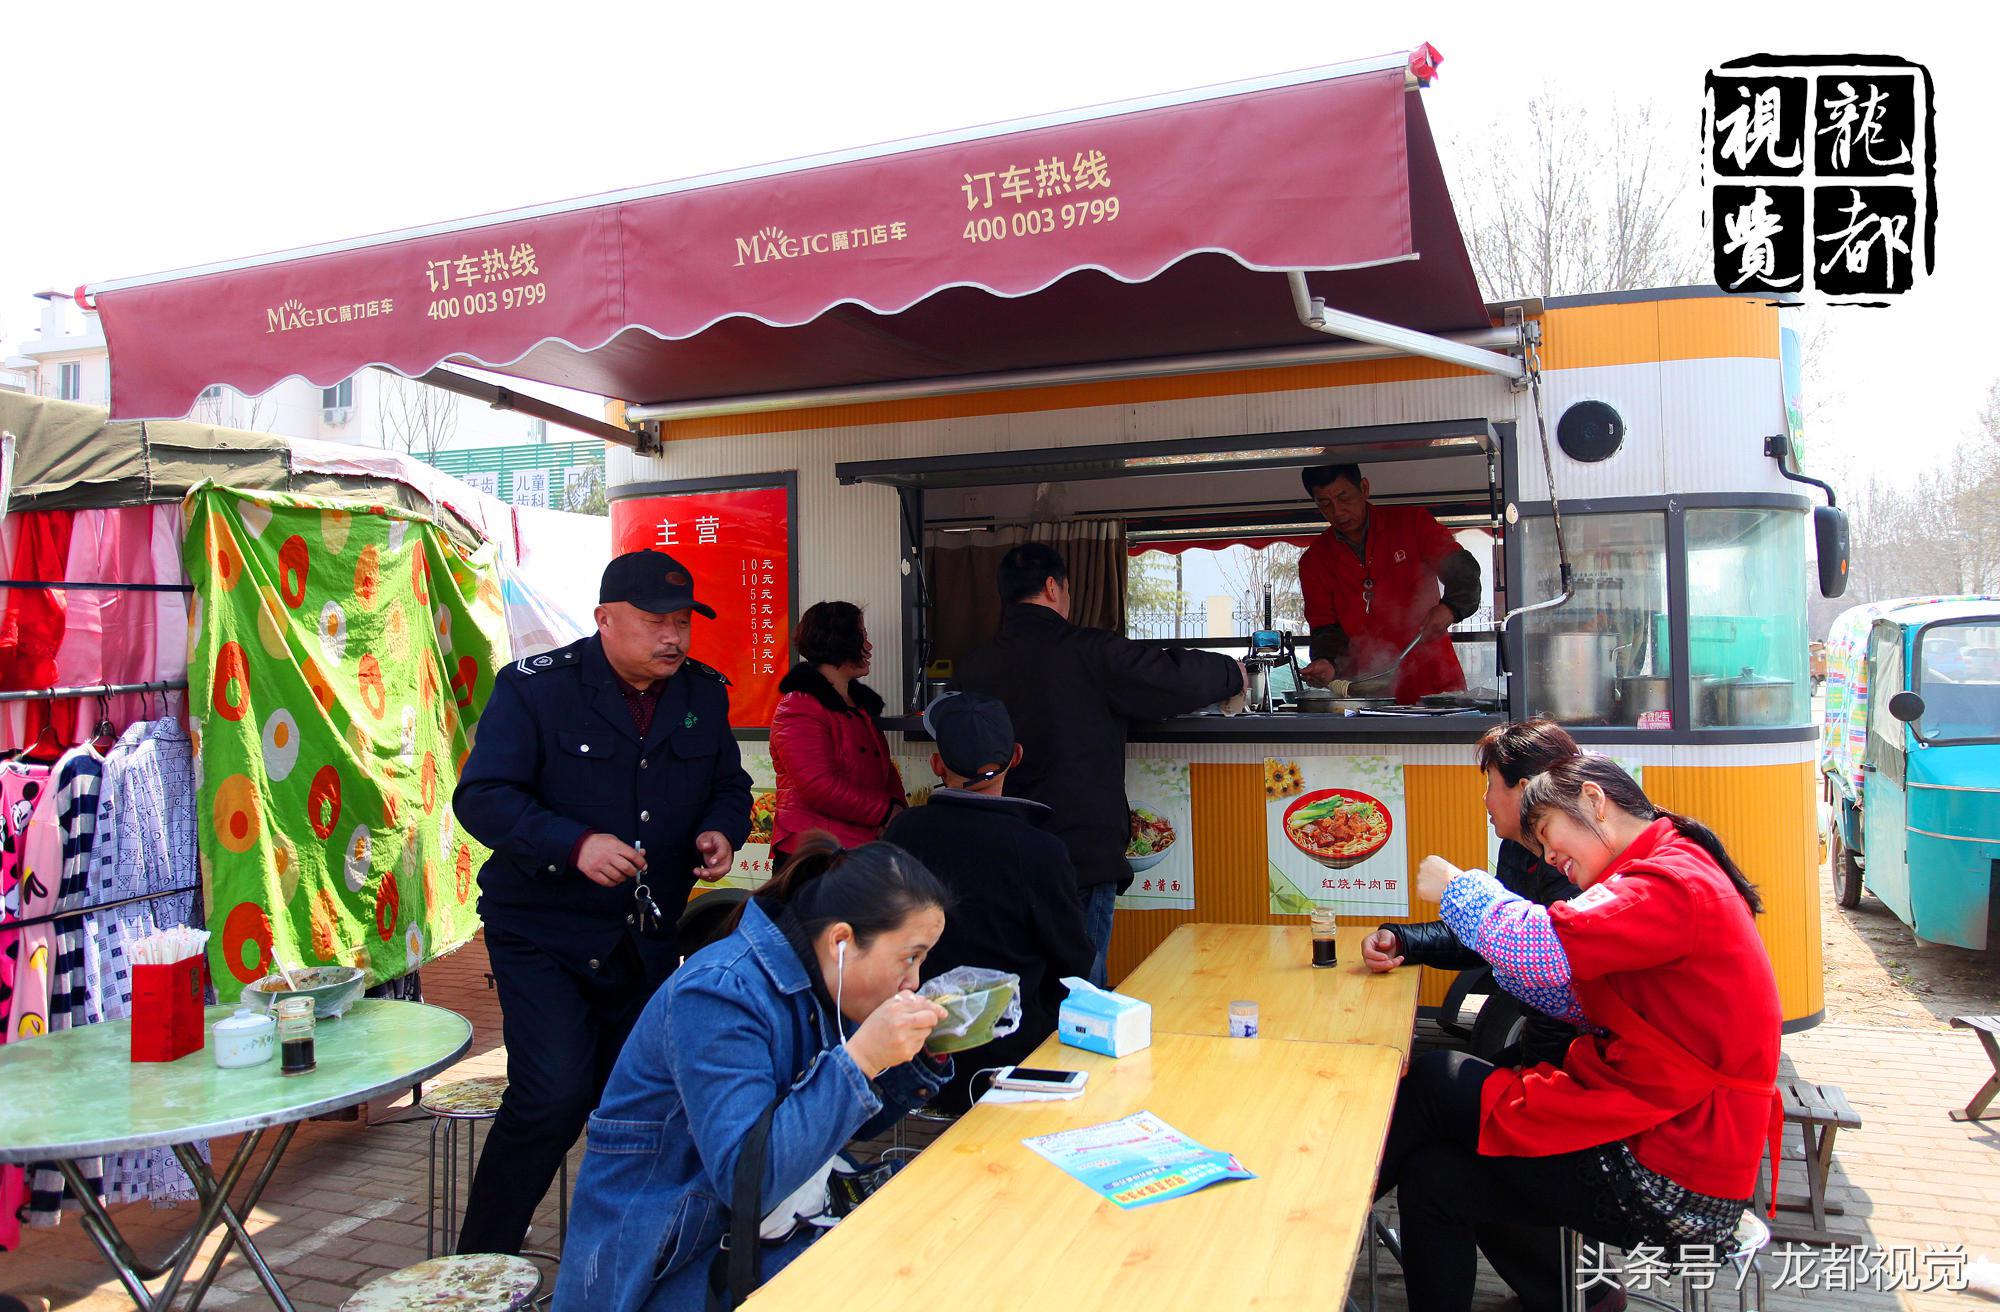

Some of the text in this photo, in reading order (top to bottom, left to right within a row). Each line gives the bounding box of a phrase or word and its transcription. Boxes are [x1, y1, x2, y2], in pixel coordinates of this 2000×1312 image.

[961, 149, 1111, 212] 订车热线
[962, 196, 1121, 244] 400 003 9799
[426, 242, 540, 293] 订车热线
[427, 282, 547, 321] 400 003 9799
[516, 474, 545, 492] 儿童
[655, 515, 719, 546] 主营
[1321, 878, 1398, 890] 红烧牛肉面
